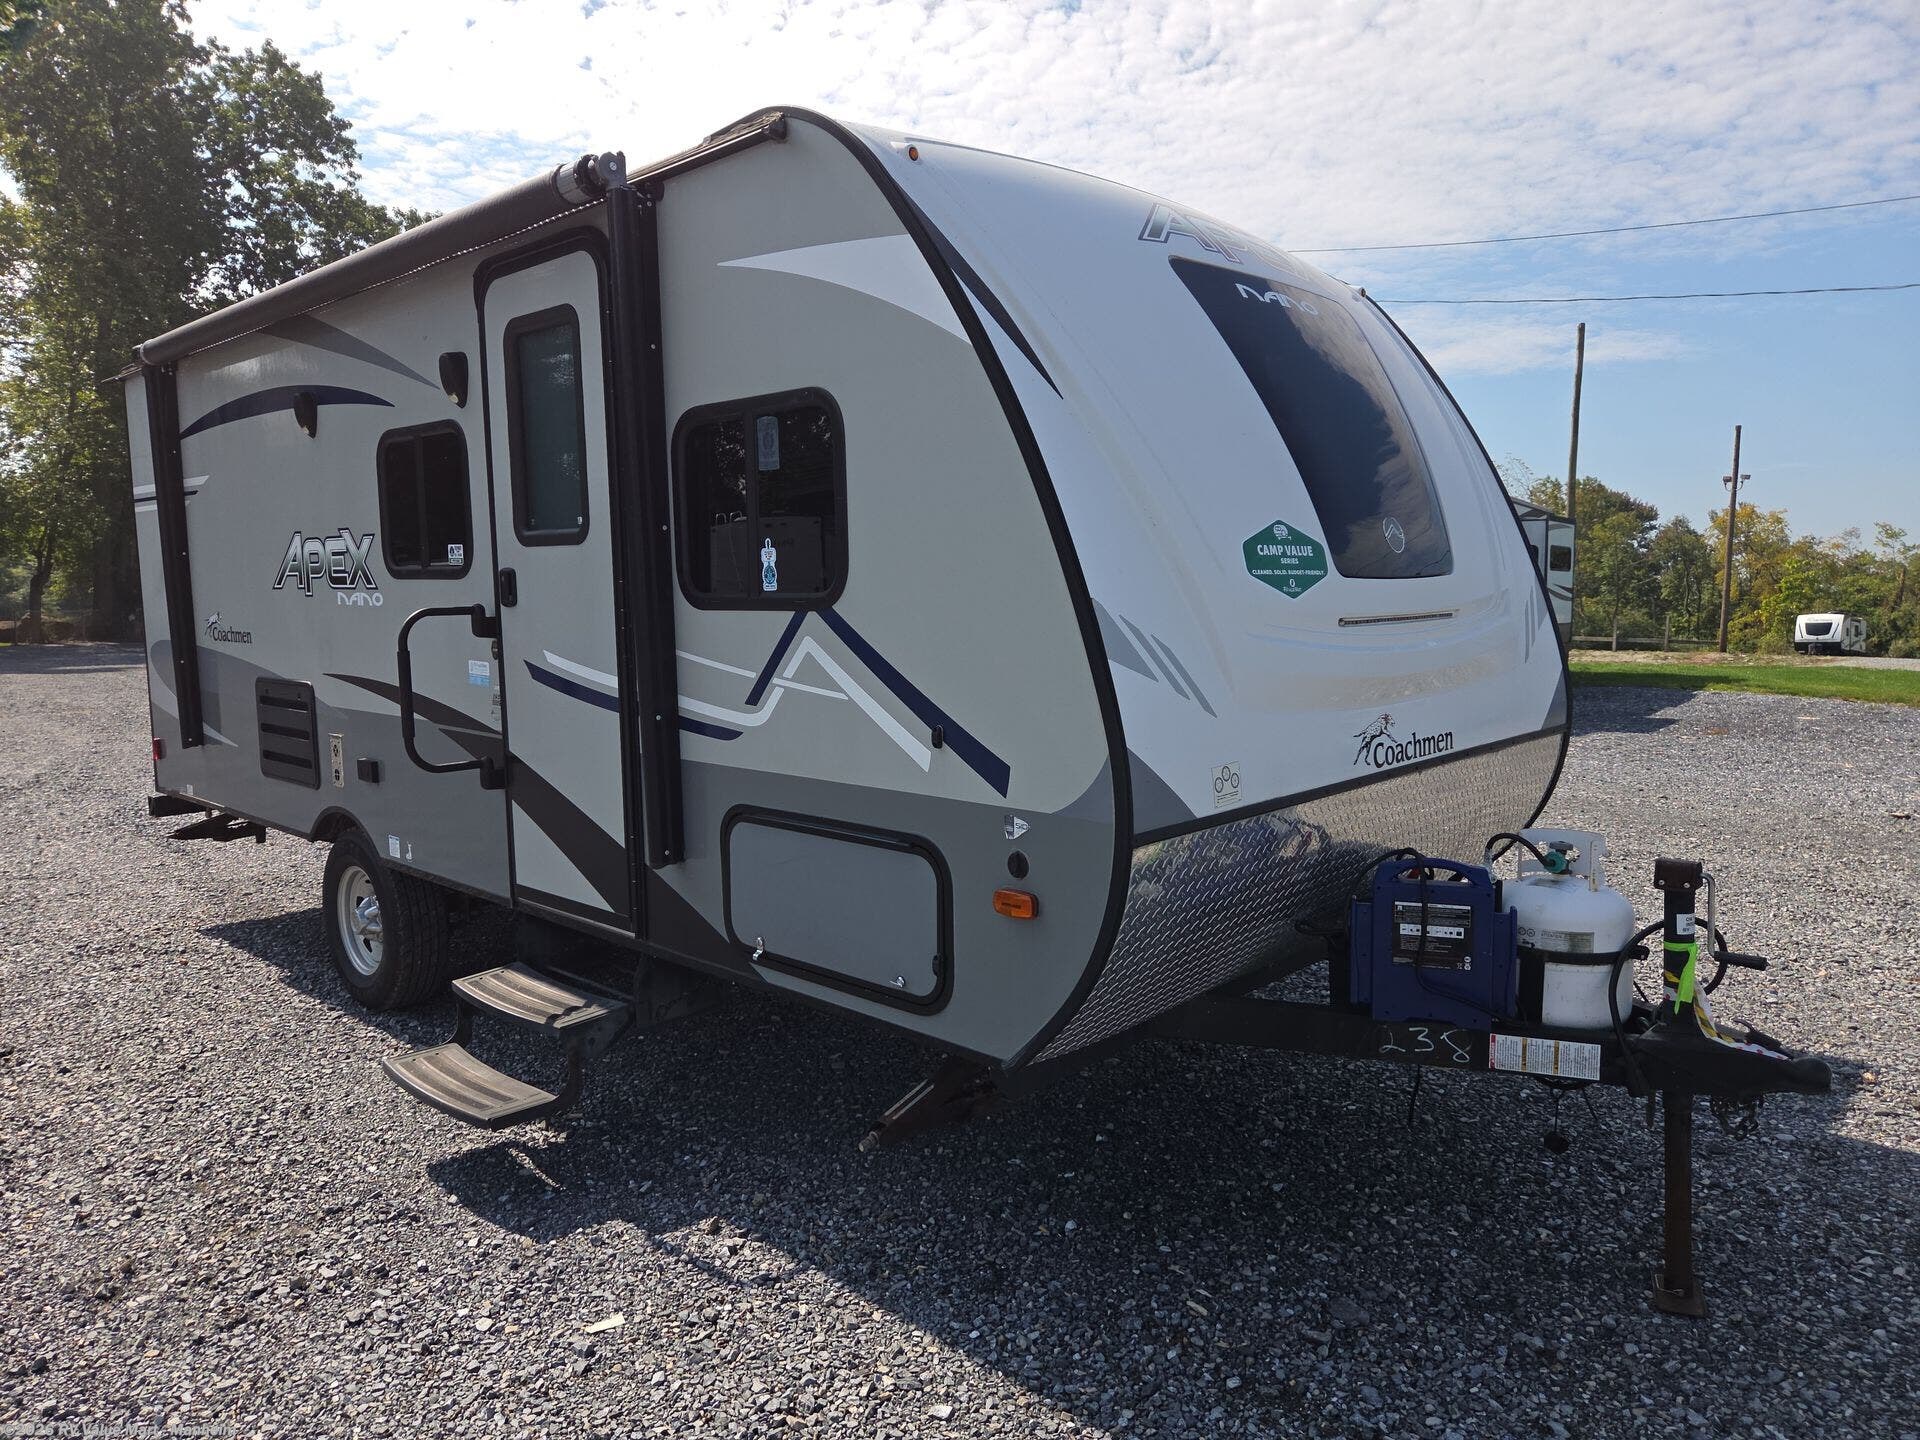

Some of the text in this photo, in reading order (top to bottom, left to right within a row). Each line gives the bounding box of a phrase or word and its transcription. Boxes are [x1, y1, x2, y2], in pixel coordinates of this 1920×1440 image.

[1257, 544, 1313, 557] CAMP VALUE
[272, 527, 379, 597] APEX
[1280, 557, 1299, 565] SERIES
[337, 591, 384, 607] NANO
[212, 626, 252, 644] Coachmen
[1373, 730, 1454, 768] Coachmen
[1379, 1025, 1472, 1063] 238
